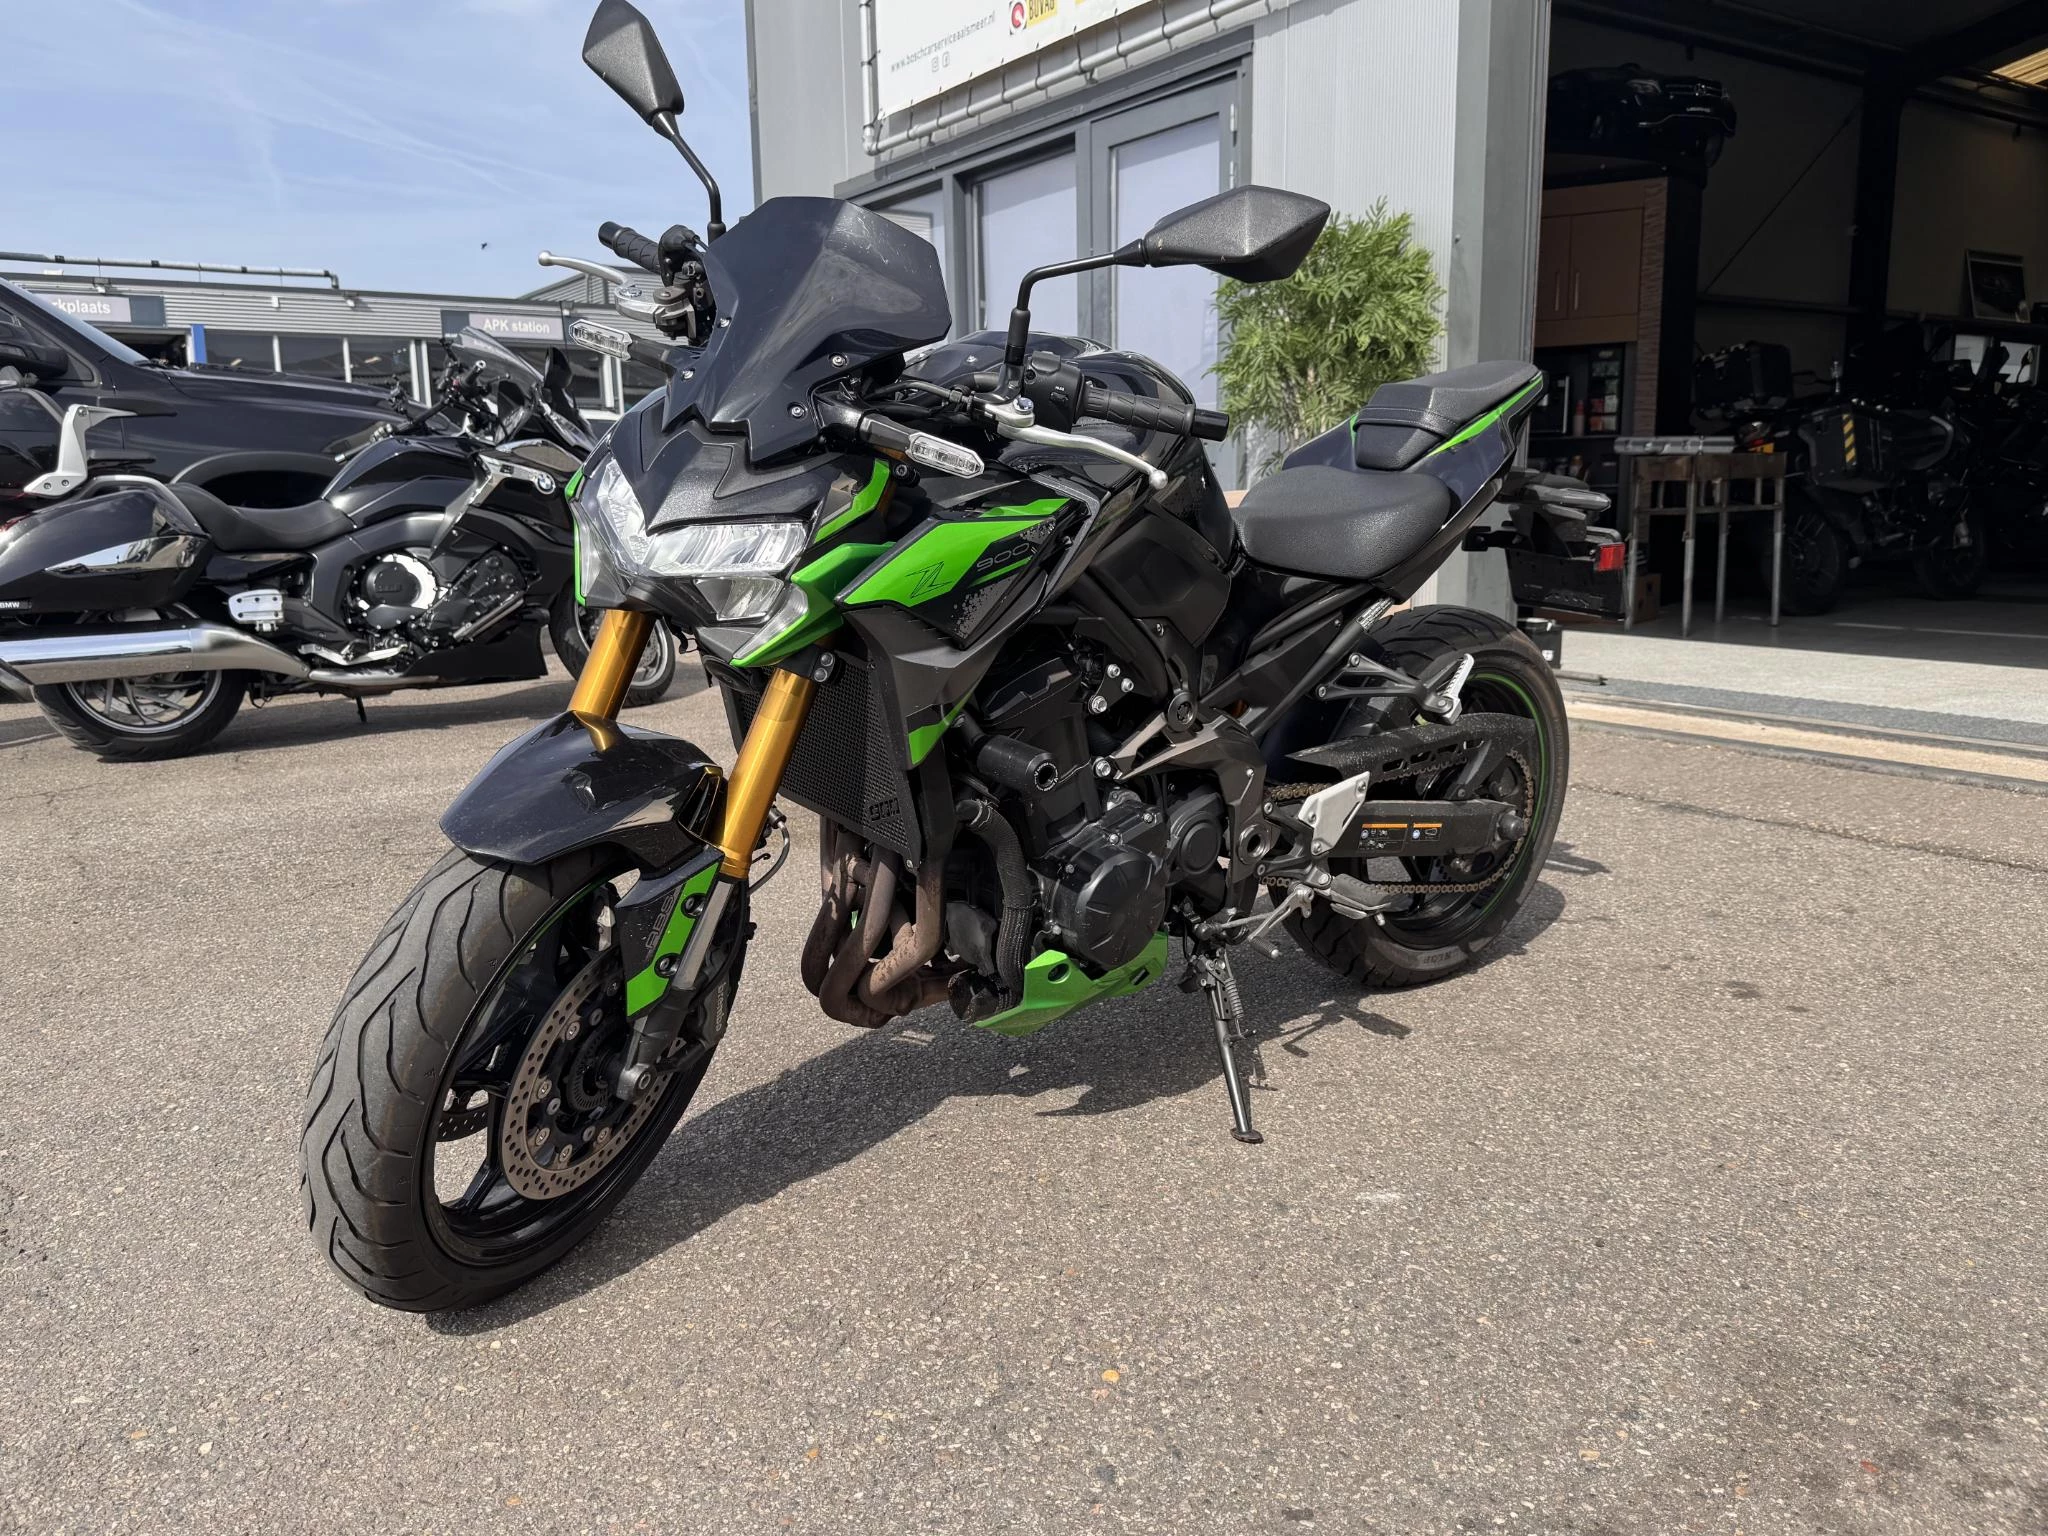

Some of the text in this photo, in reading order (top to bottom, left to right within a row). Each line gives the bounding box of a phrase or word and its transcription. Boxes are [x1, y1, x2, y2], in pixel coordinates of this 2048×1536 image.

[483, 318, 550, 334] APK station
[976, 542, 1030, 572] 900
[645, 895, 675, 949] ABS
[715, 982, 727, 1032] brembo
